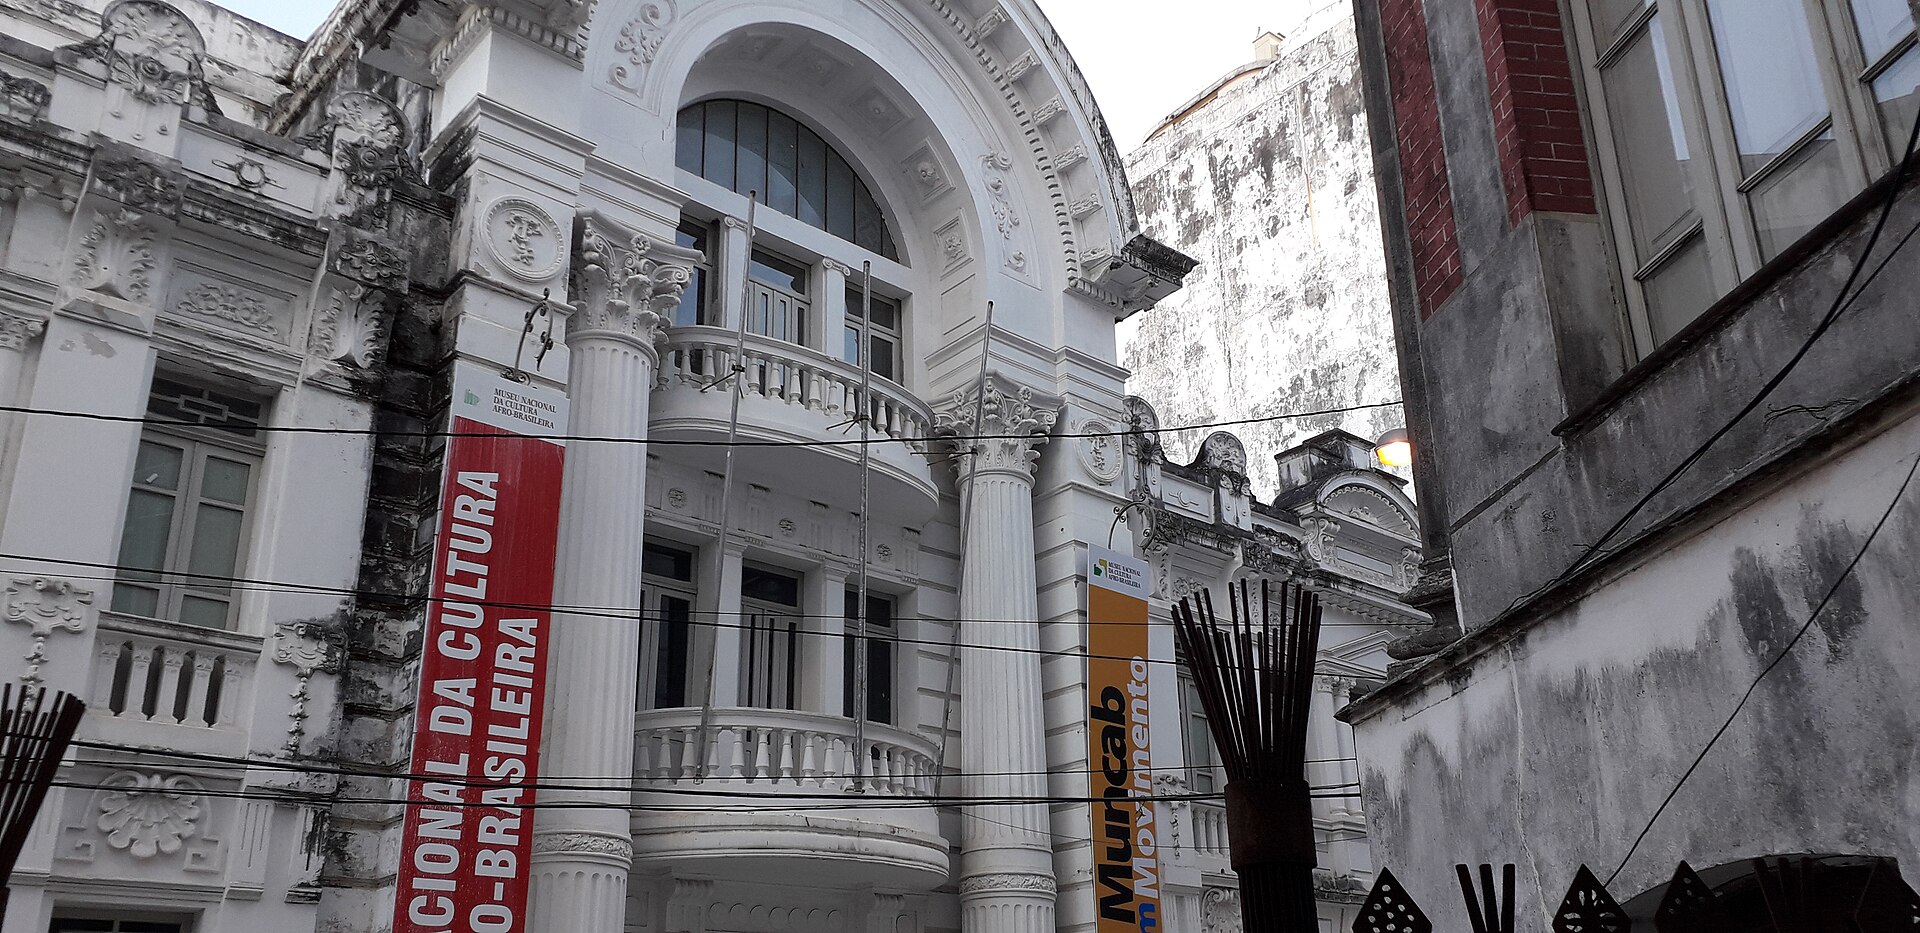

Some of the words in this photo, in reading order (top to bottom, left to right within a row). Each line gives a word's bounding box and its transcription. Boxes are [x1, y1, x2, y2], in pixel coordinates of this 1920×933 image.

[493, 405, 554, 429] AFRO-BRASILEIRA
[494, 388, 520, 401] MUSEU
[522, 397, 556, 413] NACIONAL
[494, 397, 504, 406] DA
[505, 400, 538, 416] CULTURA
[437, 471, 499, 661] CULTURA
[429, 678, 477, 736] DA
[1090, 686, 1136, 924] Muncab
[1127, 655, 1158, 899] Movimento
[408, 753, 470, 933] CIONAL
